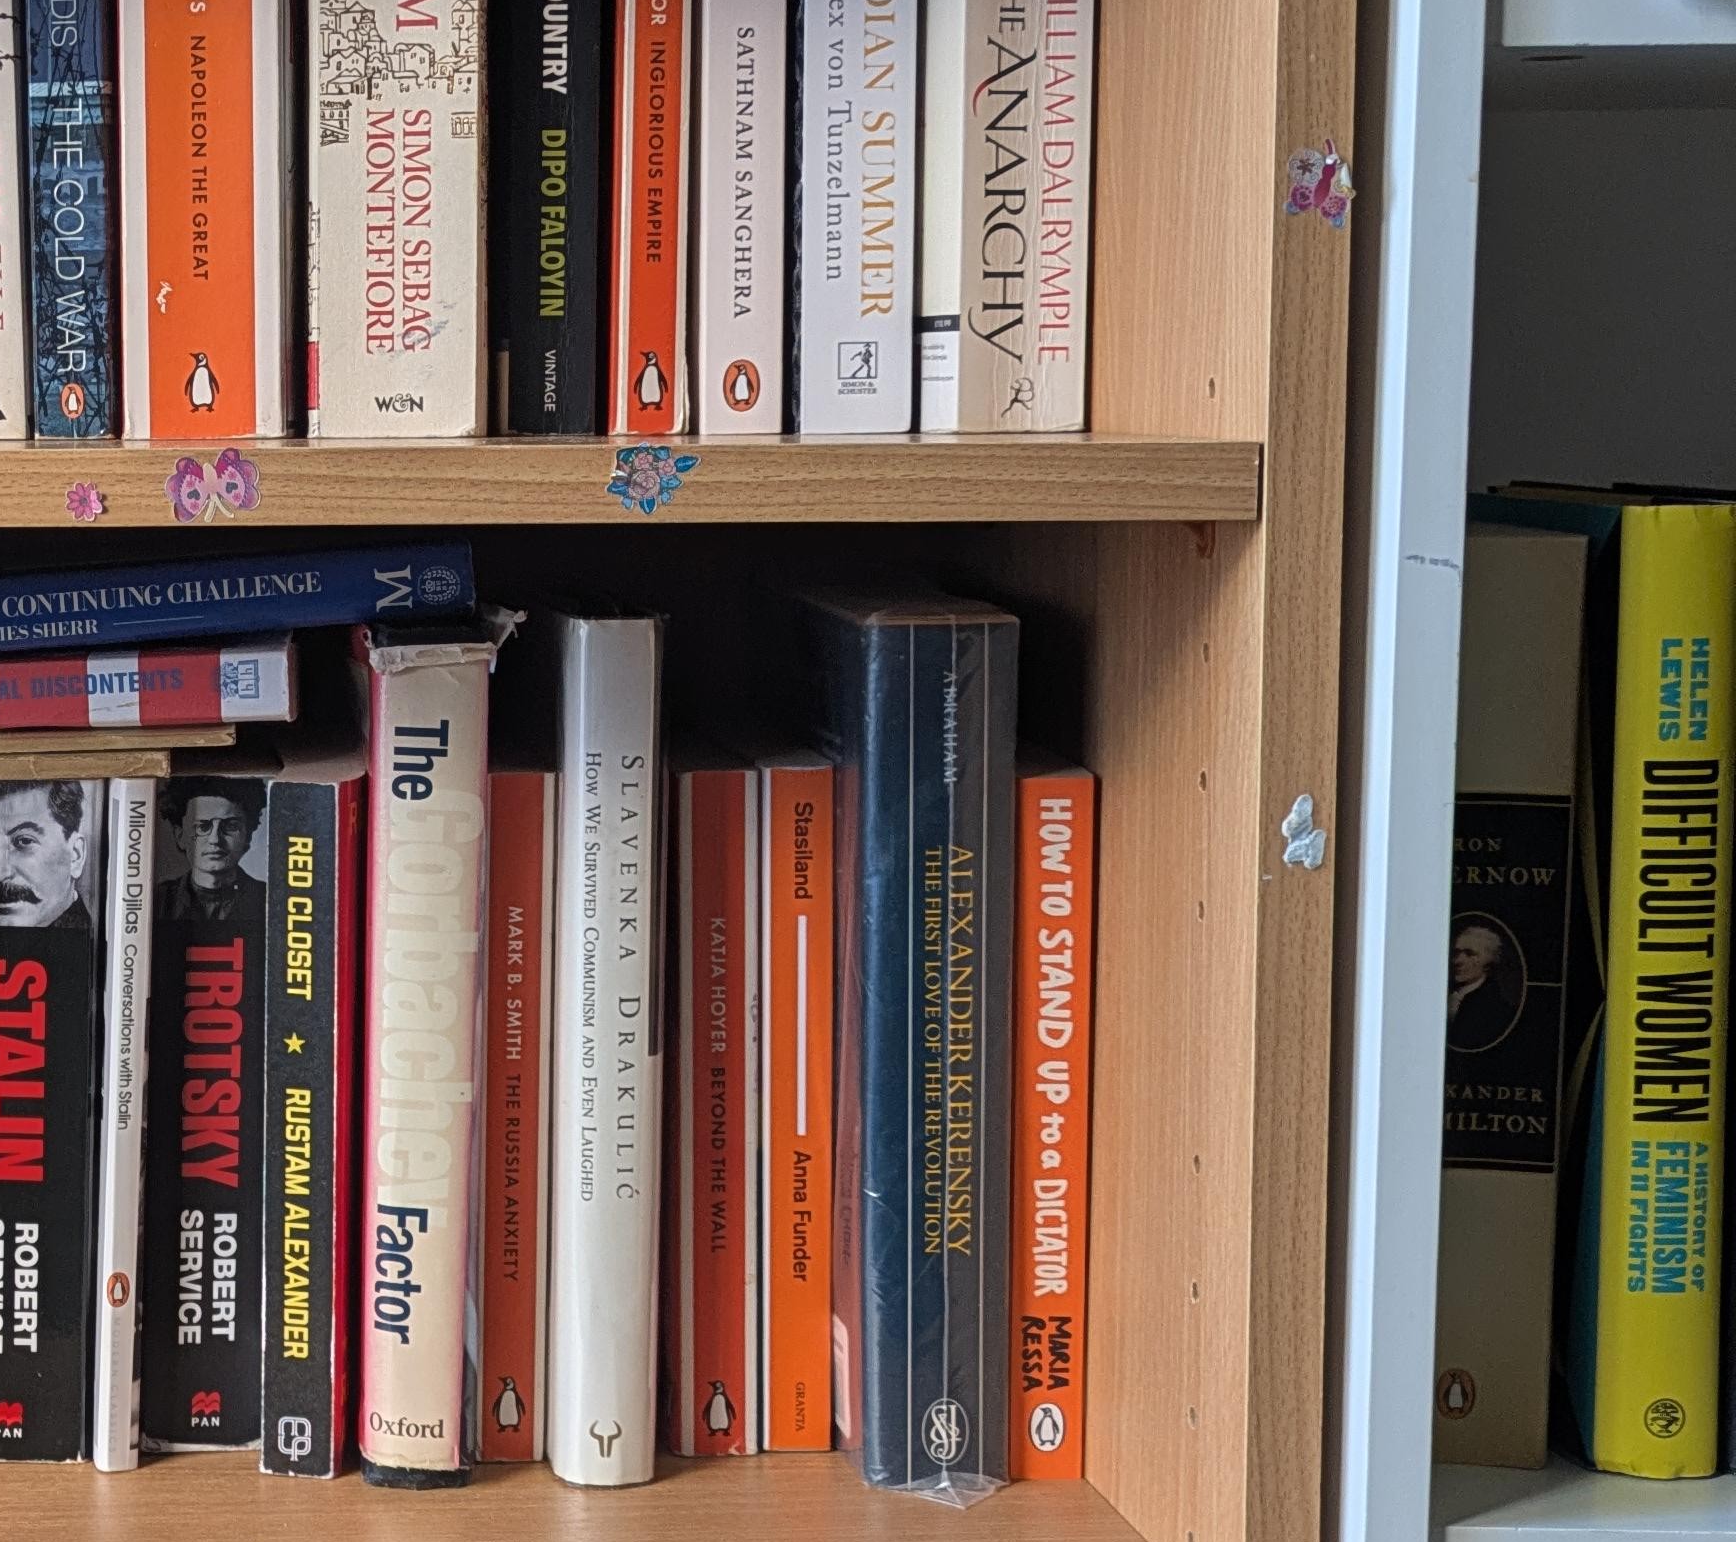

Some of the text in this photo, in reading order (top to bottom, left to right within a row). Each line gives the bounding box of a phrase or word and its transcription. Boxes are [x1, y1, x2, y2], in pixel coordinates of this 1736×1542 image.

[735, 27, 754, 160] SATHNAM
[733, 169, 753, 320] SANGHERA
[541, 349, 555, 413] VINTAGE
[0, 581, 161, 619] CONTINUING
[167, 571, 322, 603] CHALLENGE
[34, 619, 98, 640] SHERR
[1657, 637, 1684, 741] LEWIS
[1688, 637, 1710, 741] HELEN
[792, 801, 814, 901] Stasiland
[1631, 759, 1719, 1125] DIFFICULT WOMEN
[180, 936, 244, 1189] TROTSKY
[790, 1150, 812, 1282] Anna Funder
[13, 1222, 38, 1353] ROBERT
[369, 1413, 444, 1440] Oxford
